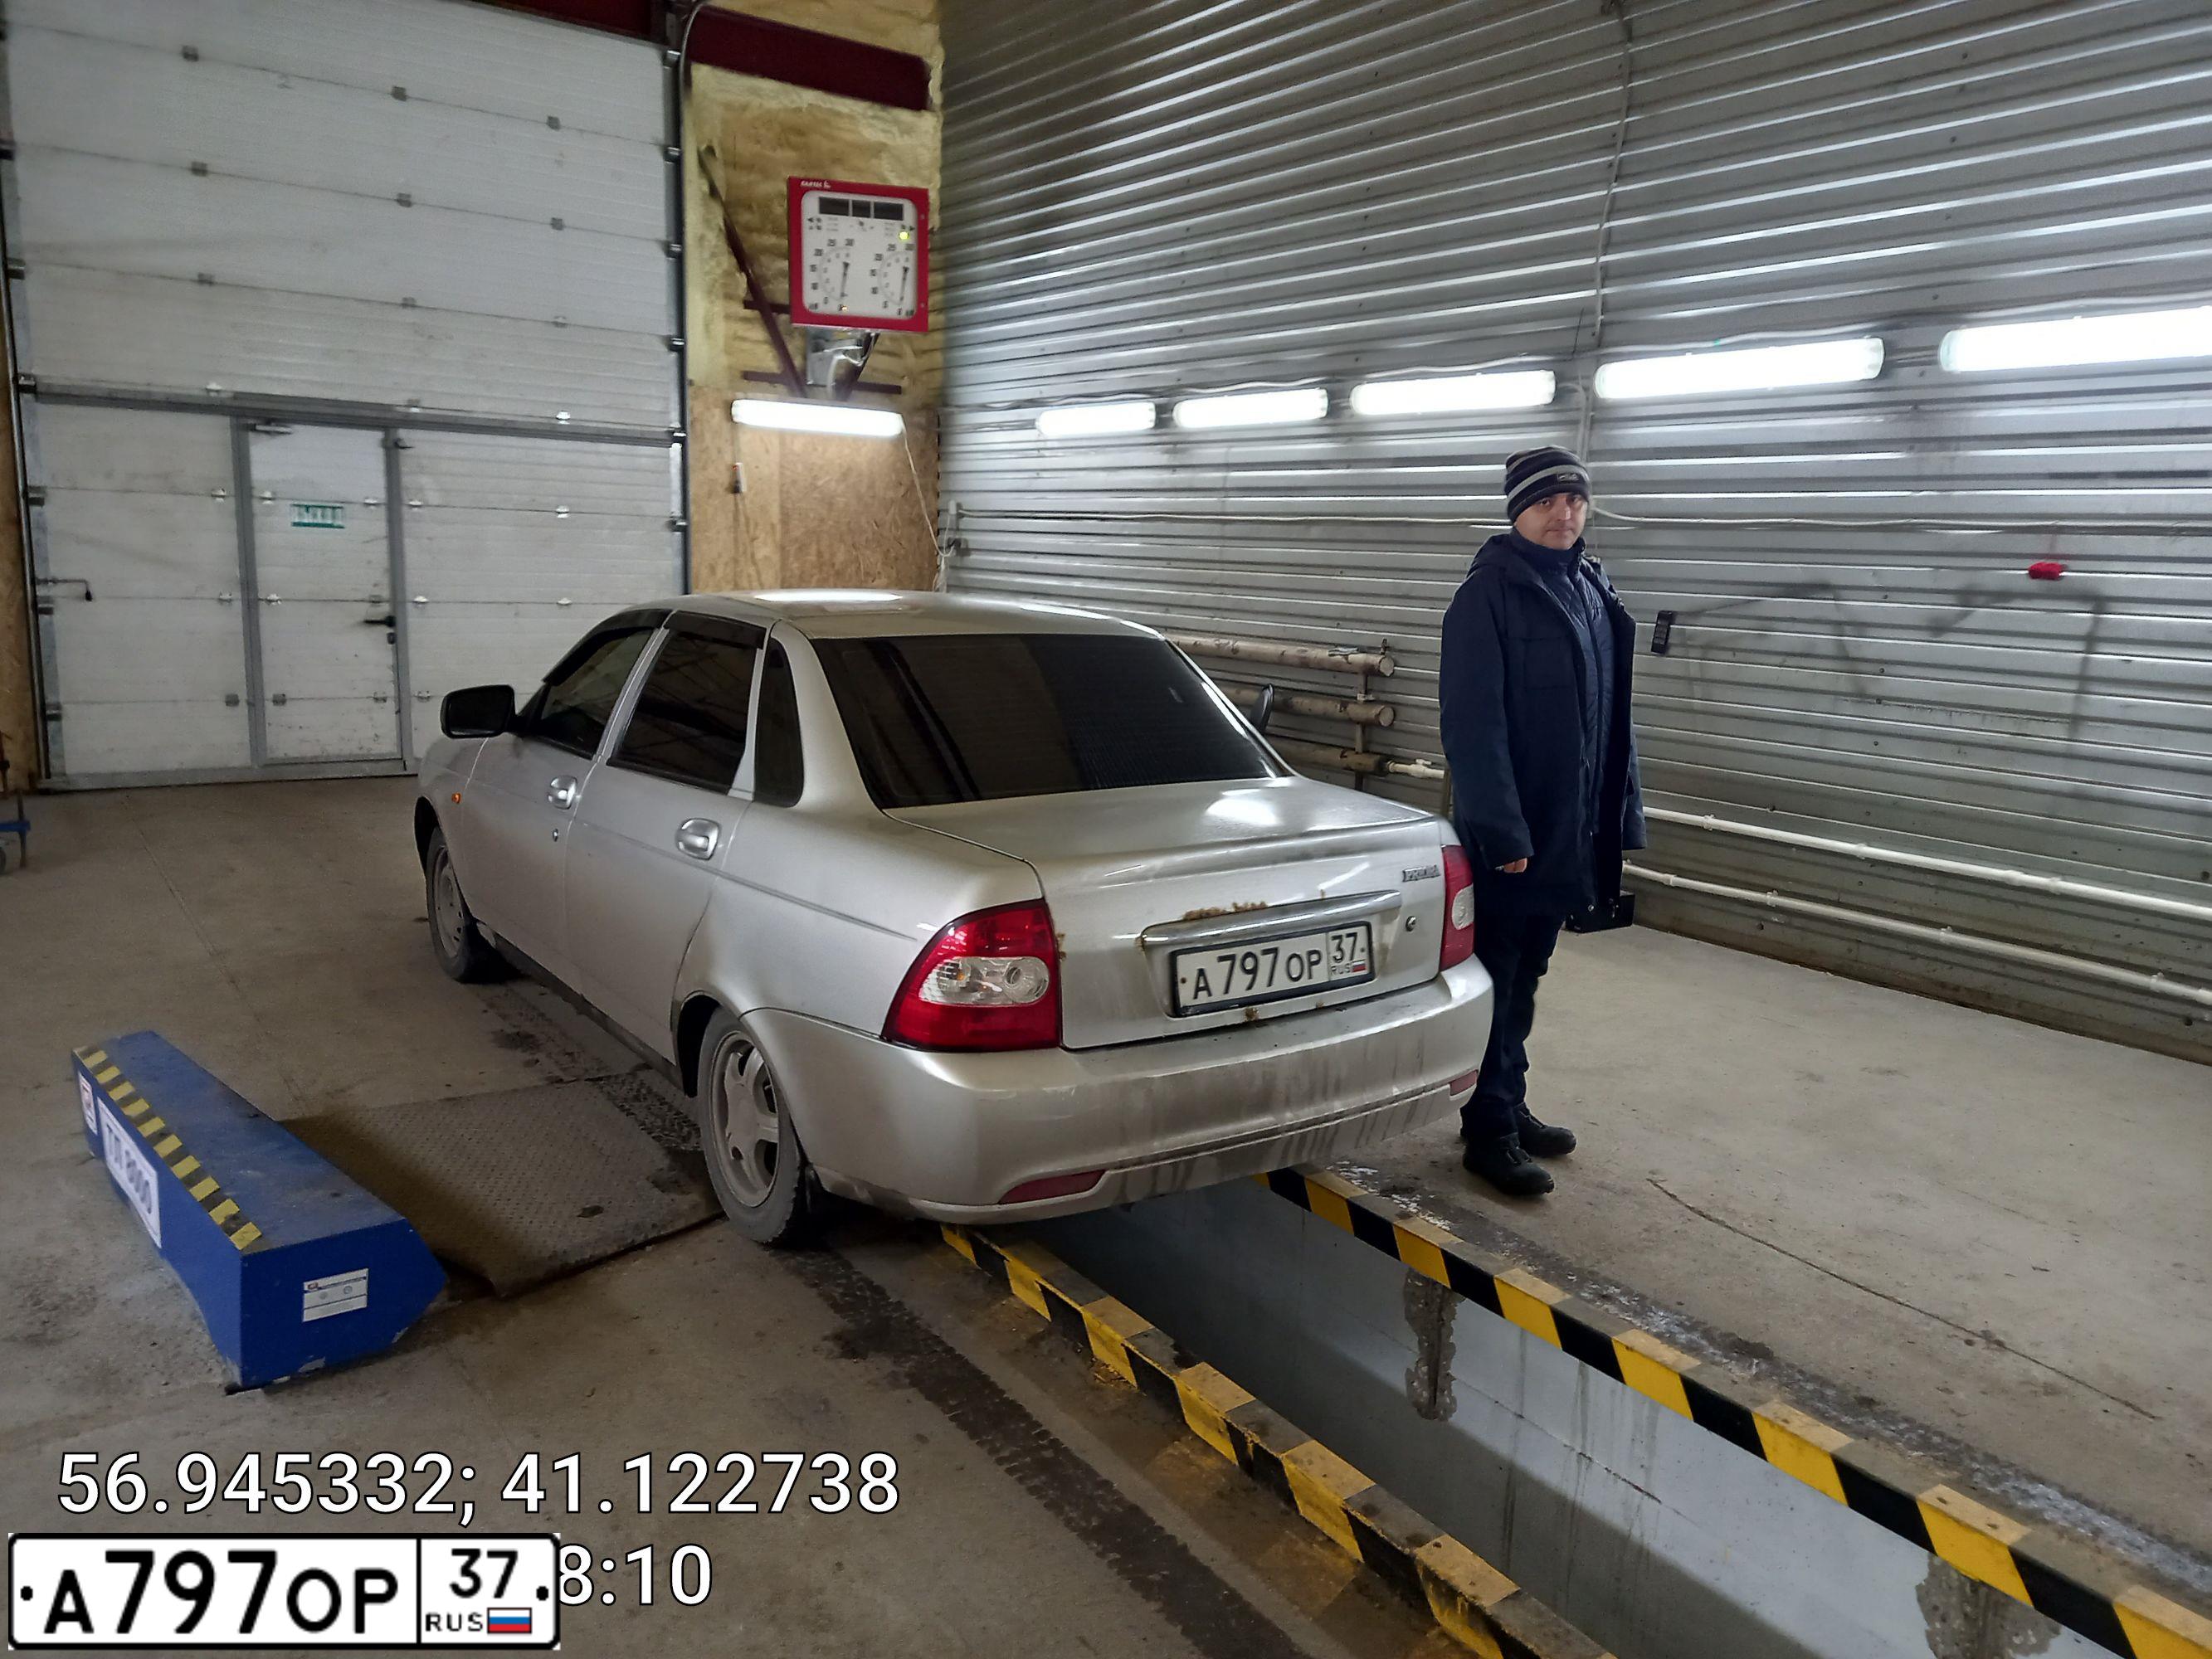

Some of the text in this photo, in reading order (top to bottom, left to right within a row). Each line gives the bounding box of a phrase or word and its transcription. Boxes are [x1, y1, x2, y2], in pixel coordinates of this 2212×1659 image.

[1192, 932, 1357, 1000] A797OP 37
[1330, 963, 1351, 975] RUS
